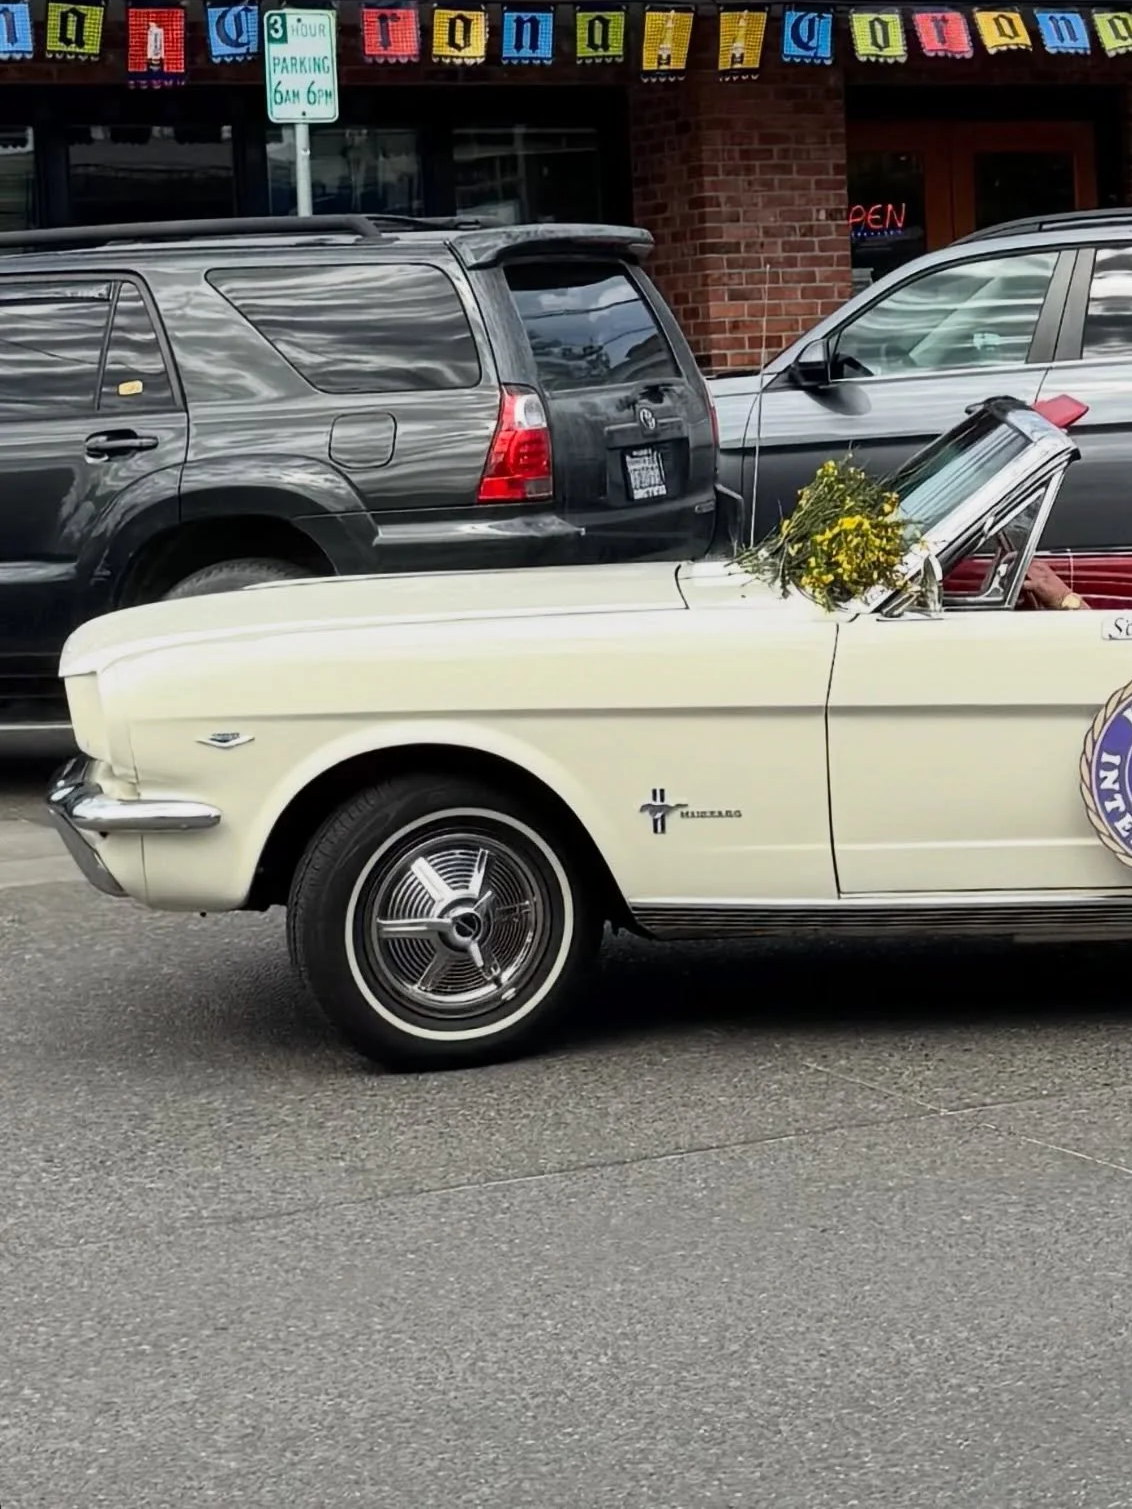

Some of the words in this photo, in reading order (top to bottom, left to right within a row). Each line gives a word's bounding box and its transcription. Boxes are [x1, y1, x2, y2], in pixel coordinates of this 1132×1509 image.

[269, 15, 284, 39] 3
[291, 24, 327, 37] HOUR
[272, 56, 330, 74] PARKING
[273, 80, 300, 105] 6AM
[306, 80, 333, 106] 6PM
[848, 202, 906, 231] PEN
